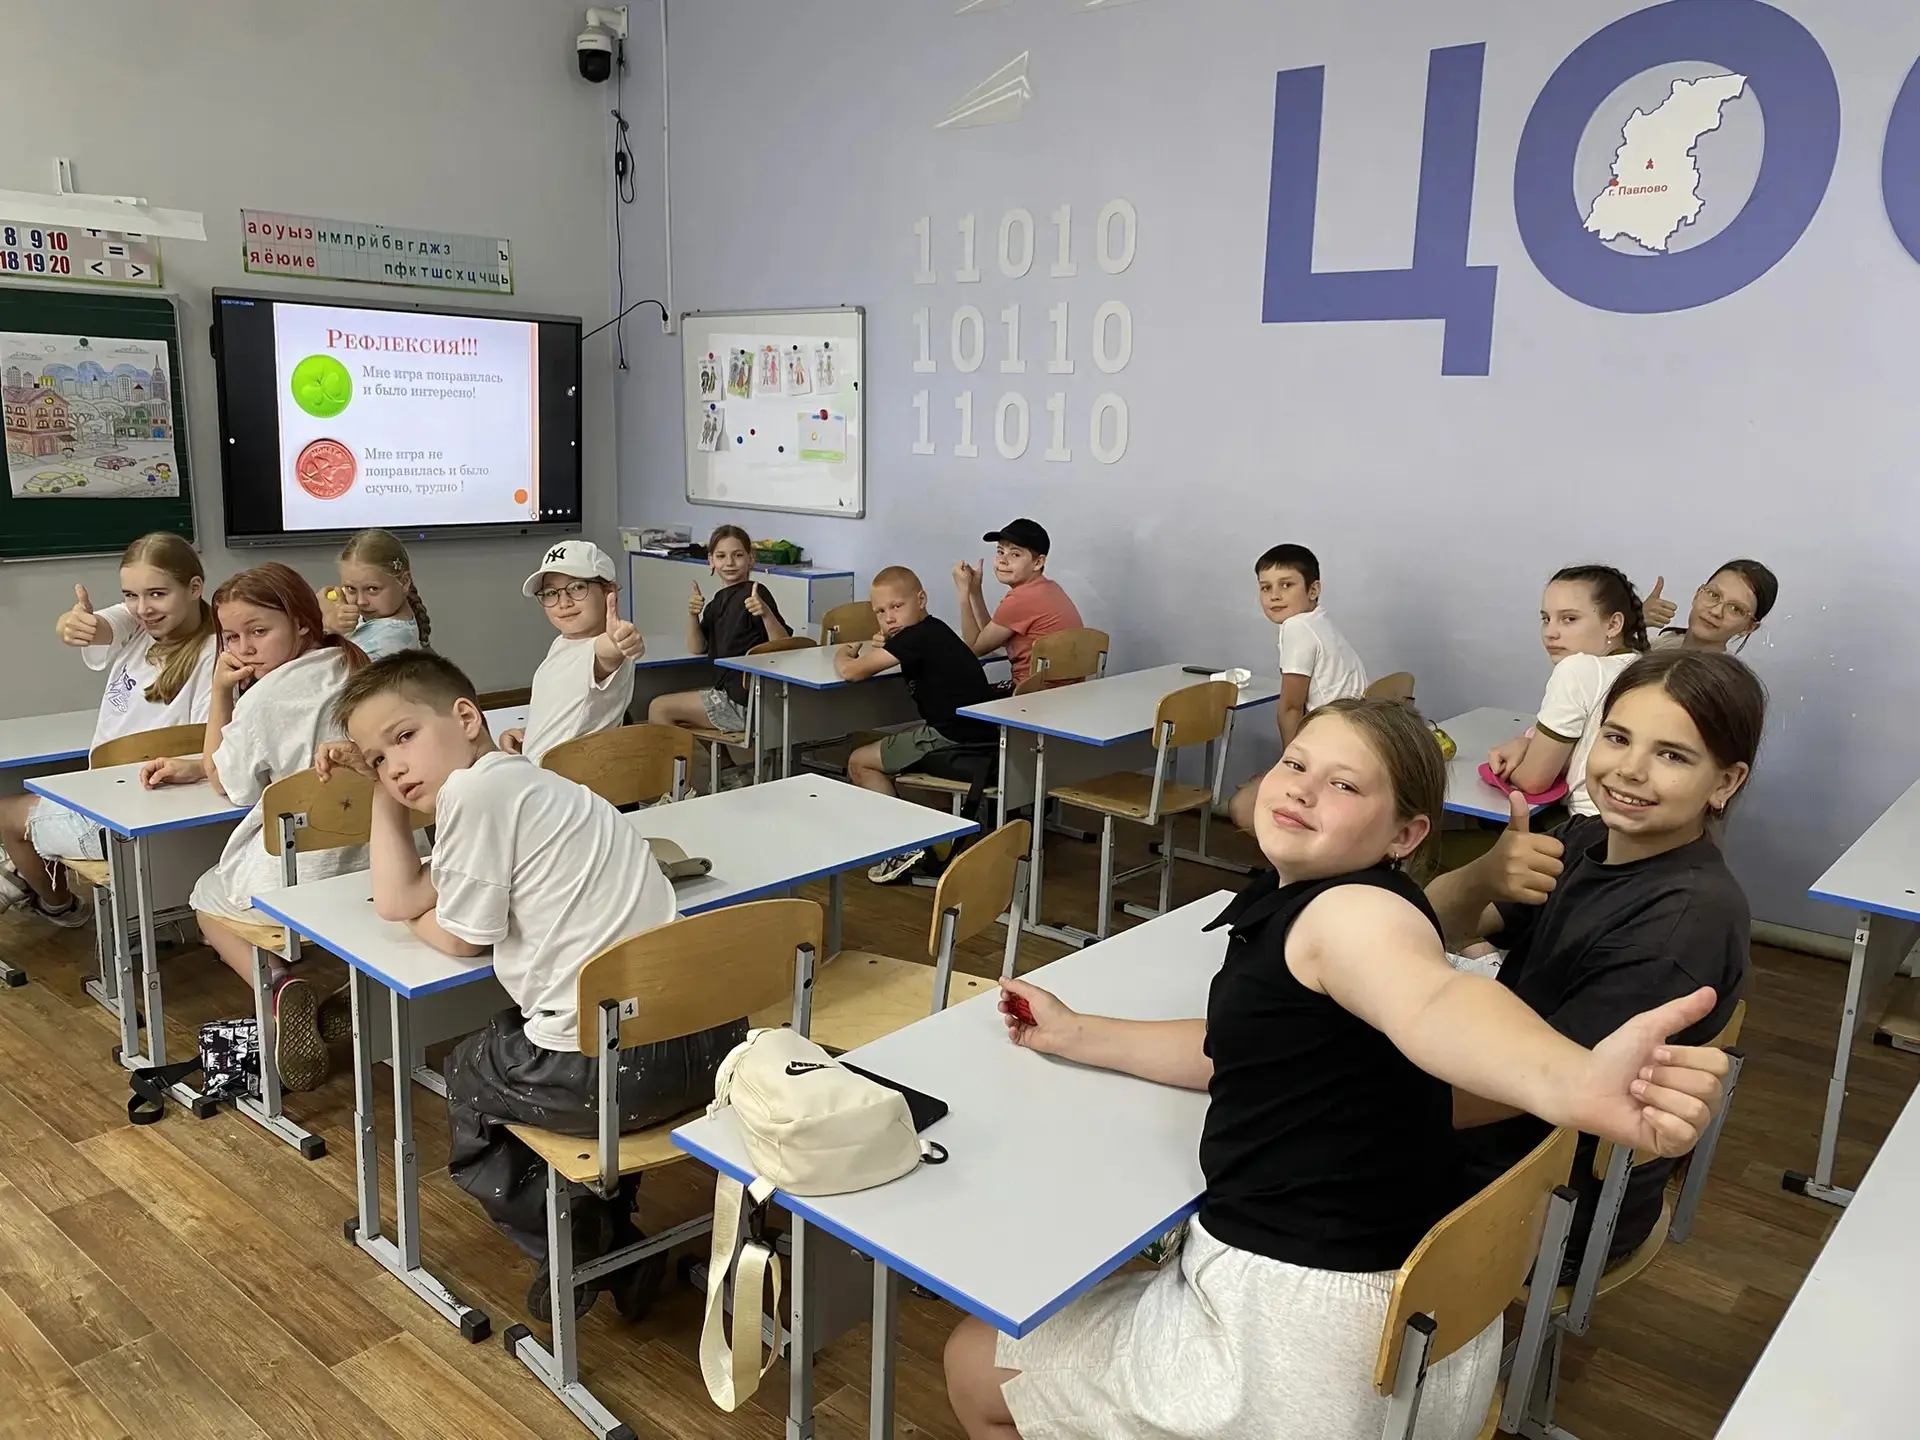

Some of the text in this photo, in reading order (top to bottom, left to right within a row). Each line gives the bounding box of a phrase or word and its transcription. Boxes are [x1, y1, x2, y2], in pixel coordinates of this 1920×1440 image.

[1262, 0, 1920, 376] ЦО
[1608, 184, 1668, 197] г. Павлово
[4, 226, 17, 246] 8
[30, 229, 43, 249] 9
[47, 231, 68, 251] 10
[24, 253, 45, 272] 19
[50, 254, 70, 274] 20
[362, 365, 503, 384] Мне игра понравилась
[363, 383, 476, 399] и было интересно!
[364, 447, 443, 462] Мне игра не
[365, 464, 489, 479] понравилась и было
[365, 483, 412, 496] скучно,
[415, 482, 458, 495] трудно
[295, 816, 304, 826] 4
[1856, 932, 1865, 943] 4
[624, 1002, 634, 1016] 4
